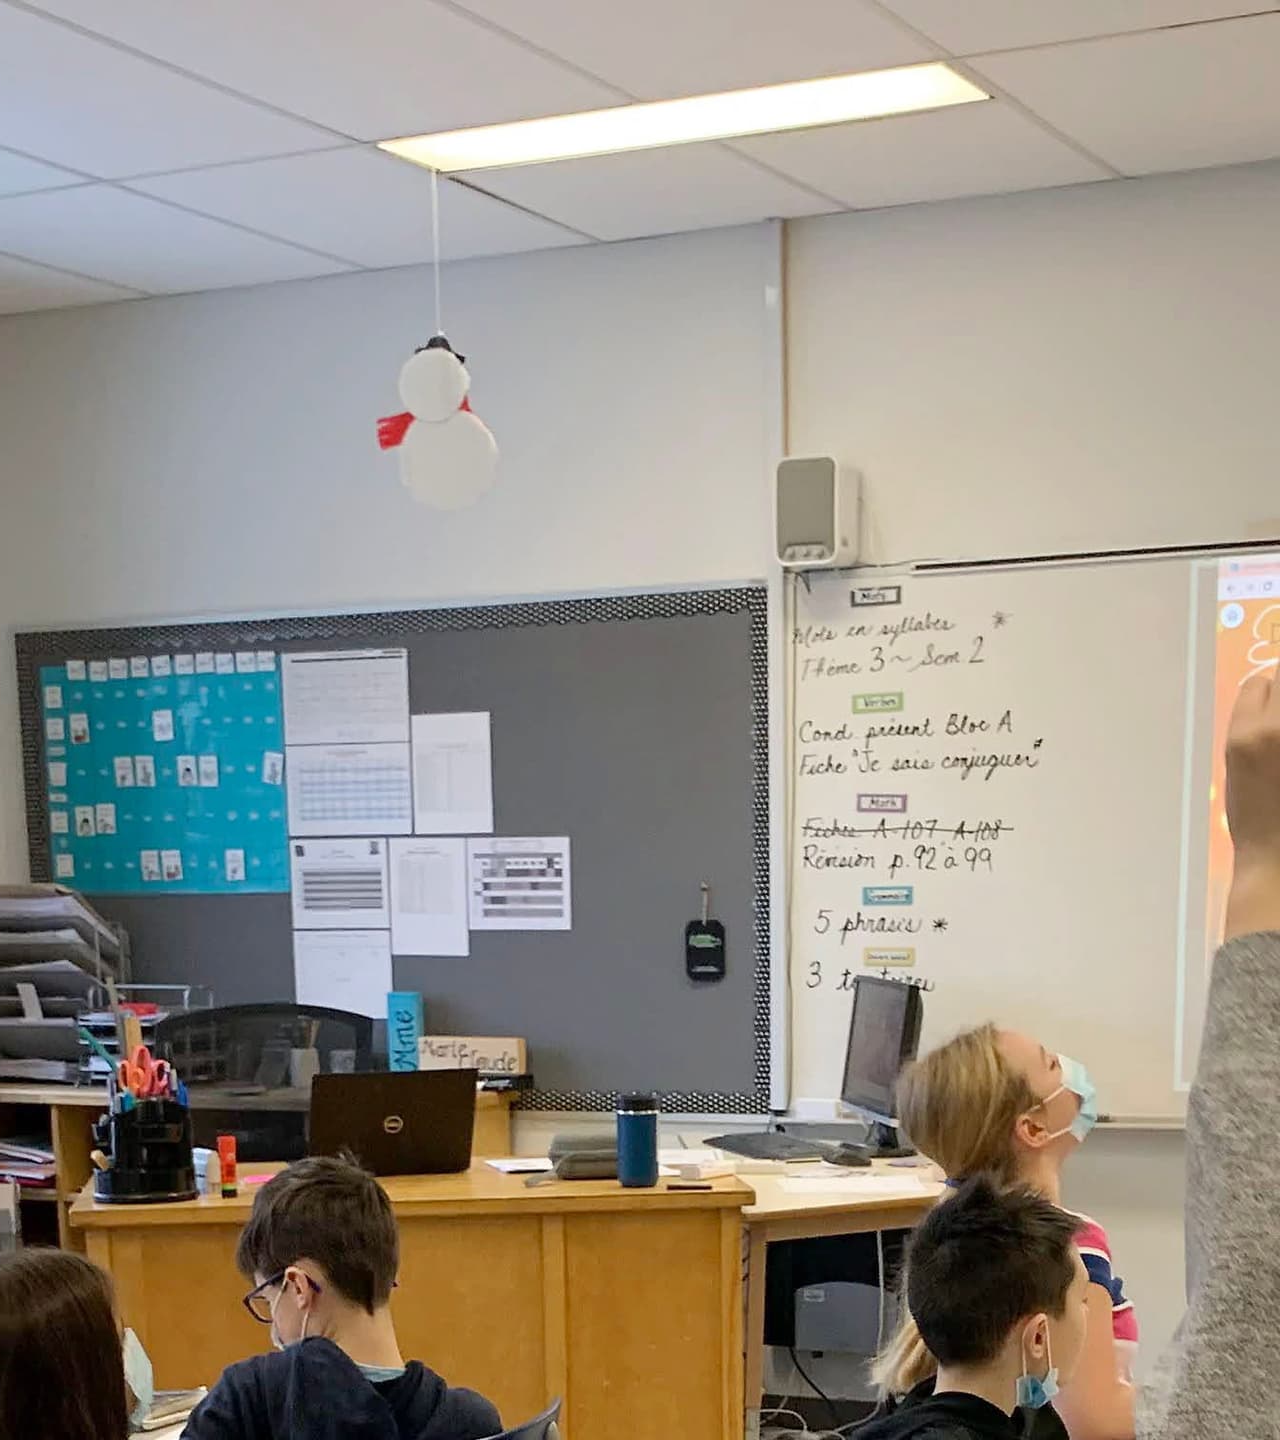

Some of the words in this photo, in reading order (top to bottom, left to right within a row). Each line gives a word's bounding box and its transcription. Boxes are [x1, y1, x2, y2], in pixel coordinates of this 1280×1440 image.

[869, 646, 886, 673] 3
[968, 634, 985, 664] 2
[996, 709, 1014, 734] A
[963, 846, 994, 873] 99
[813, 908, 835, 935] 5
[805, 961, 824, 990] 3
